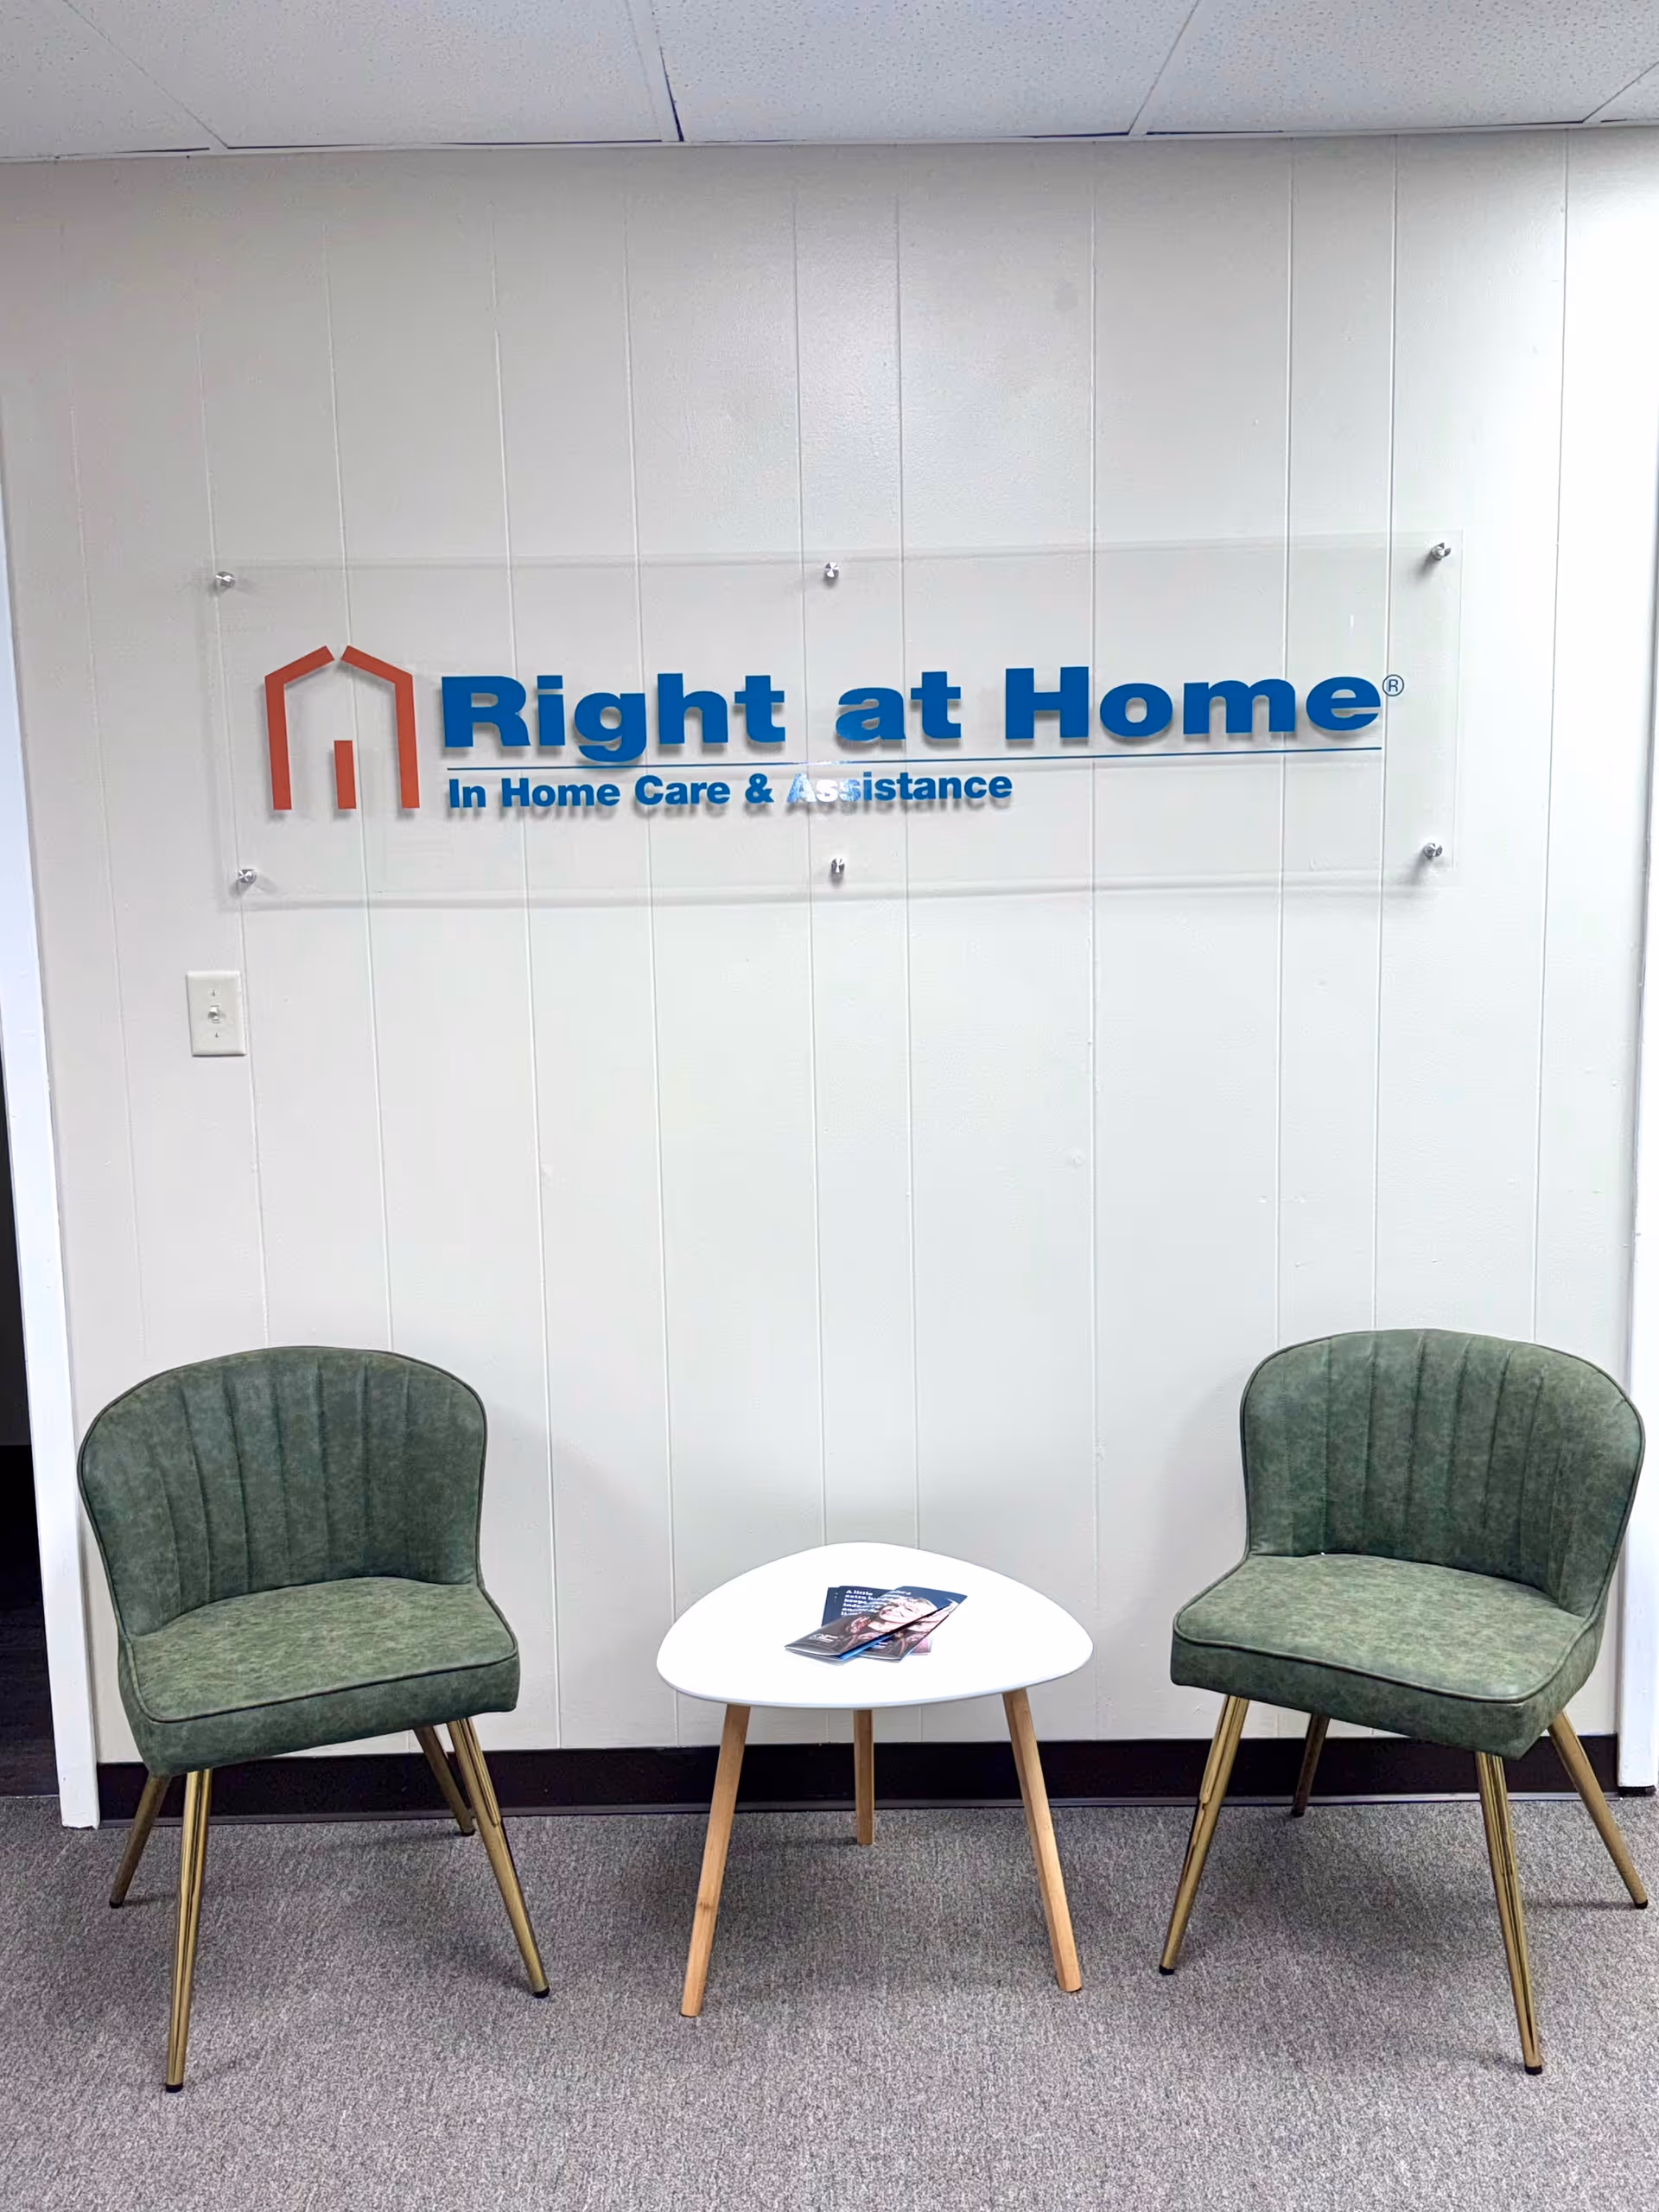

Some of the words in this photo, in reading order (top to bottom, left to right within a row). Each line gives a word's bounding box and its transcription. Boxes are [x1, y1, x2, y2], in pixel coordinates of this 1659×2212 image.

[442, 672, 785, 763] Right
[835, 675, 962, 742] at
[448, 779, 486, 809] In
[501, 777, 621, 808] Home
[634, 774, 731, 806] Care
[745, 772, 774, 804] &
[786, 771, 1013, 804] Assistance
